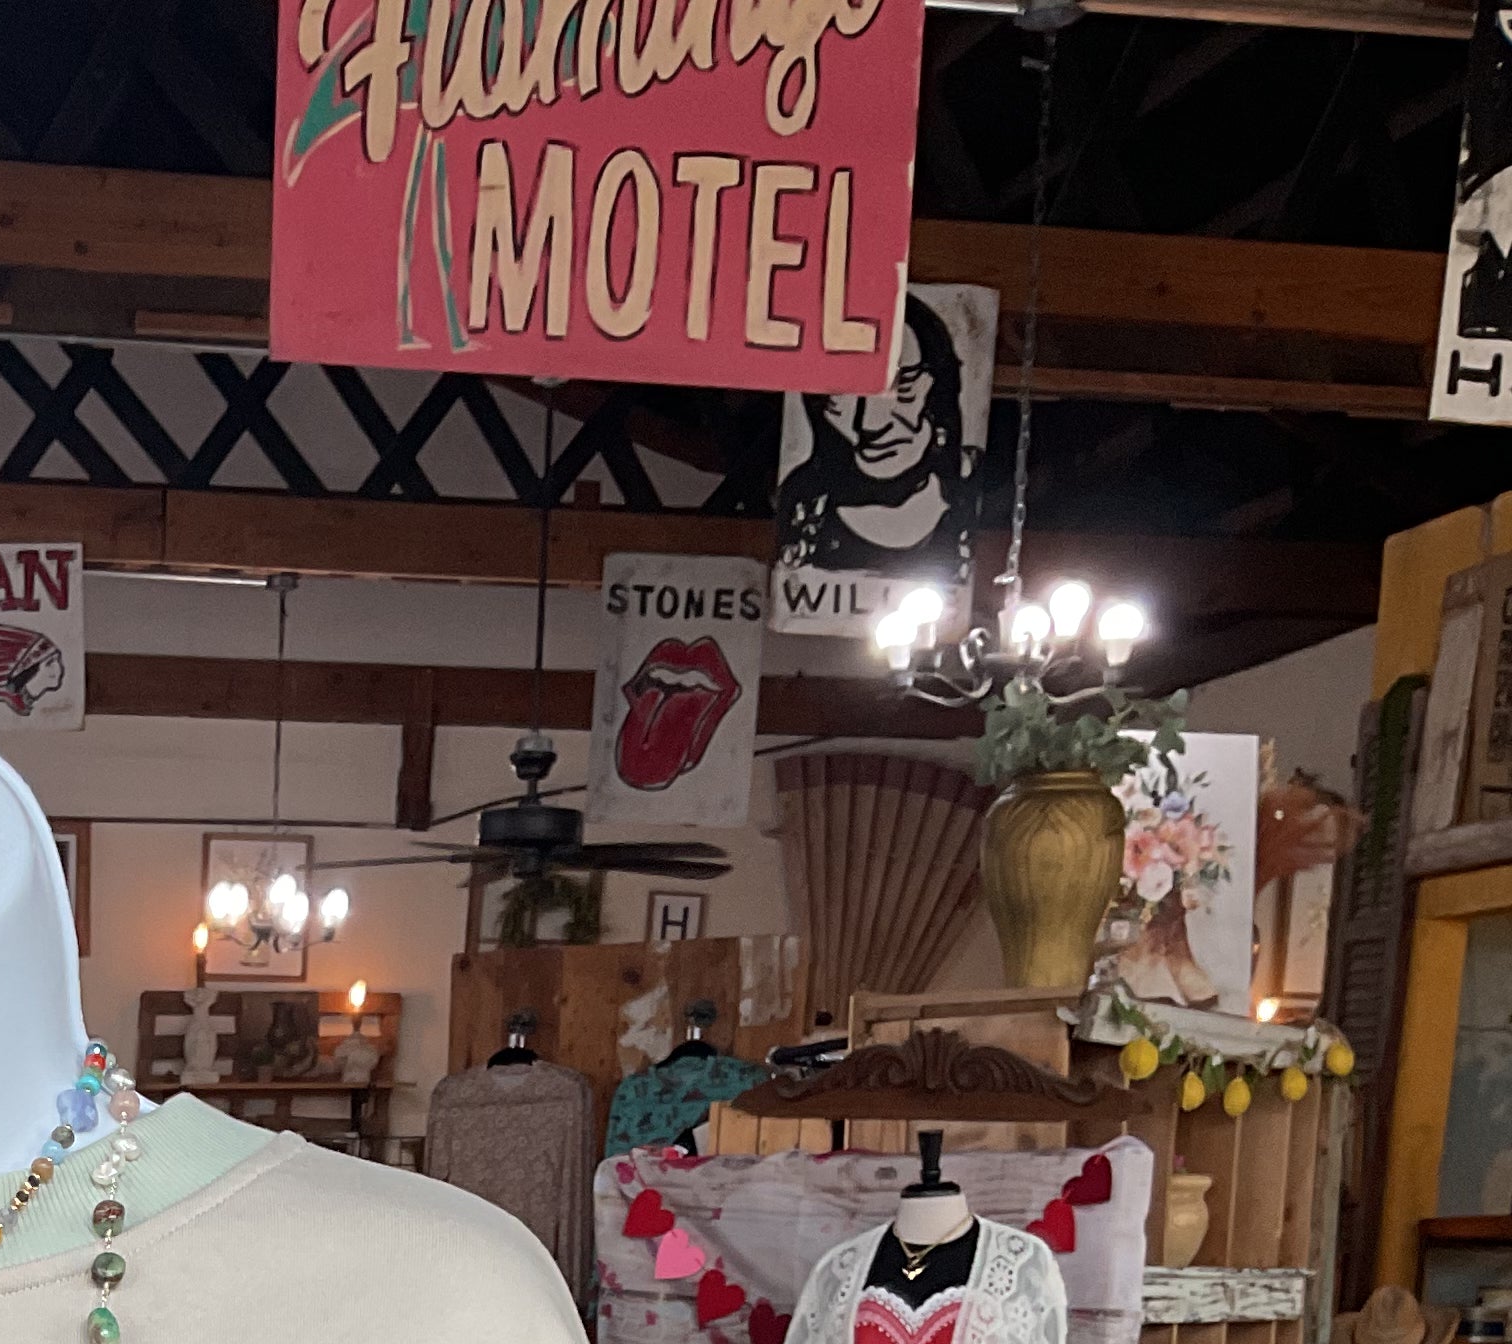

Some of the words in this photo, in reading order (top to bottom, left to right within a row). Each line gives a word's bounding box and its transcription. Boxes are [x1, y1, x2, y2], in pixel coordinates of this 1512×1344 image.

[468, 138, 881, 353] MOTEL
[606, 583, 762, 622] STONES
[660, 905, 689, 940] H
